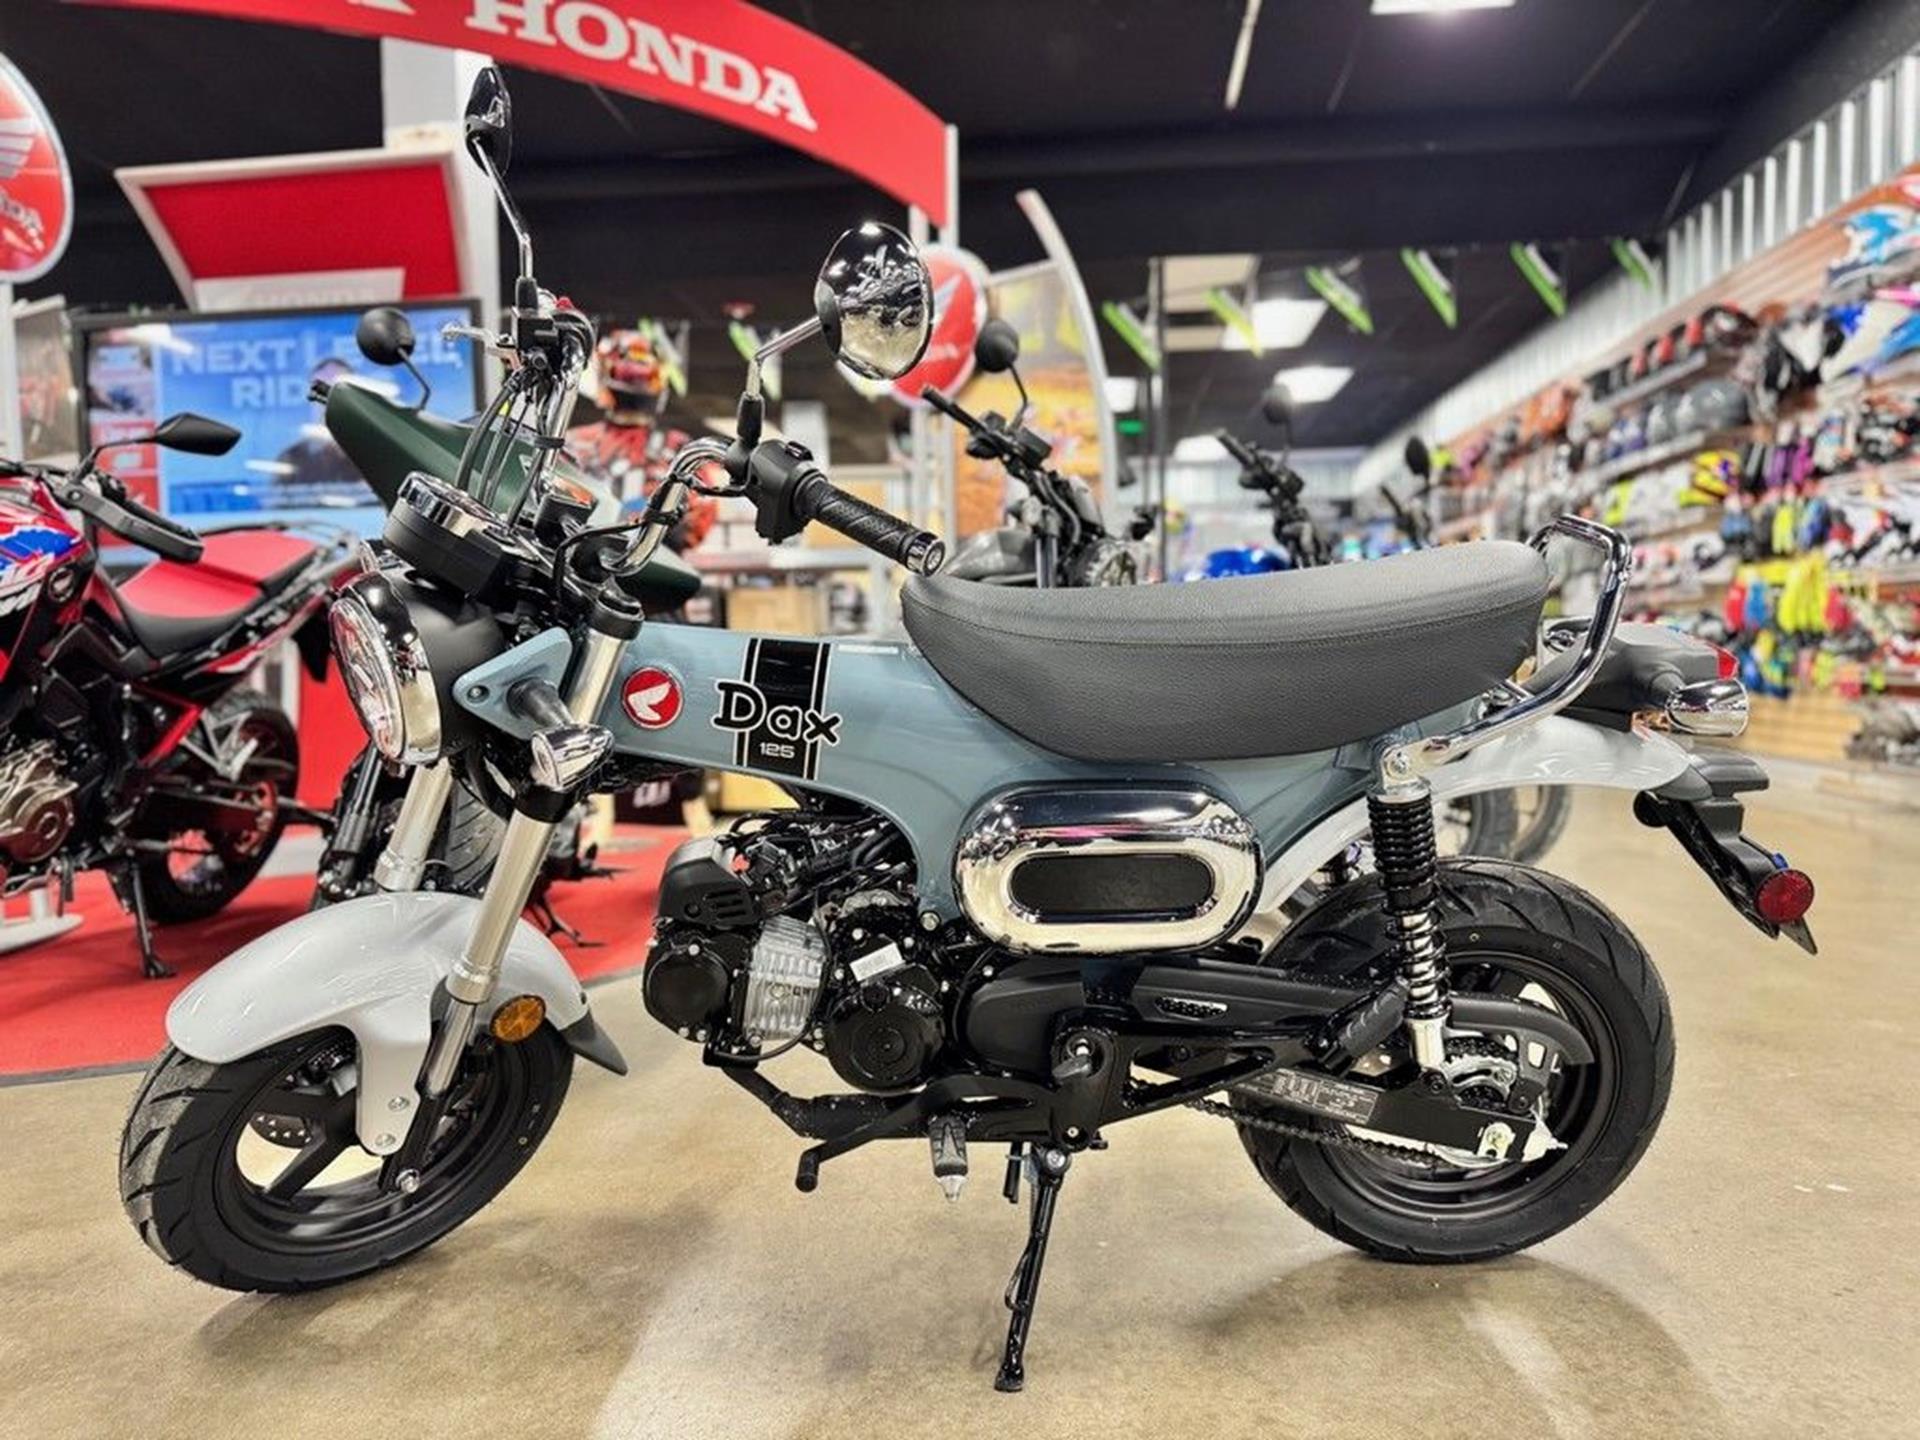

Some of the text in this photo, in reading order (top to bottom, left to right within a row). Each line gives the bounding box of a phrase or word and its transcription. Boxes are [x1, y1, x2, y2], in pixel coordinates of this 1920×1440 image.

[464, 0, 819, 133] HONDA
[172, 339, 298, 376] NEXT
[231, 375, 307, 409] RID
[710, 679, 842, 748] Dax
[760, 742, 796, 759] 125
